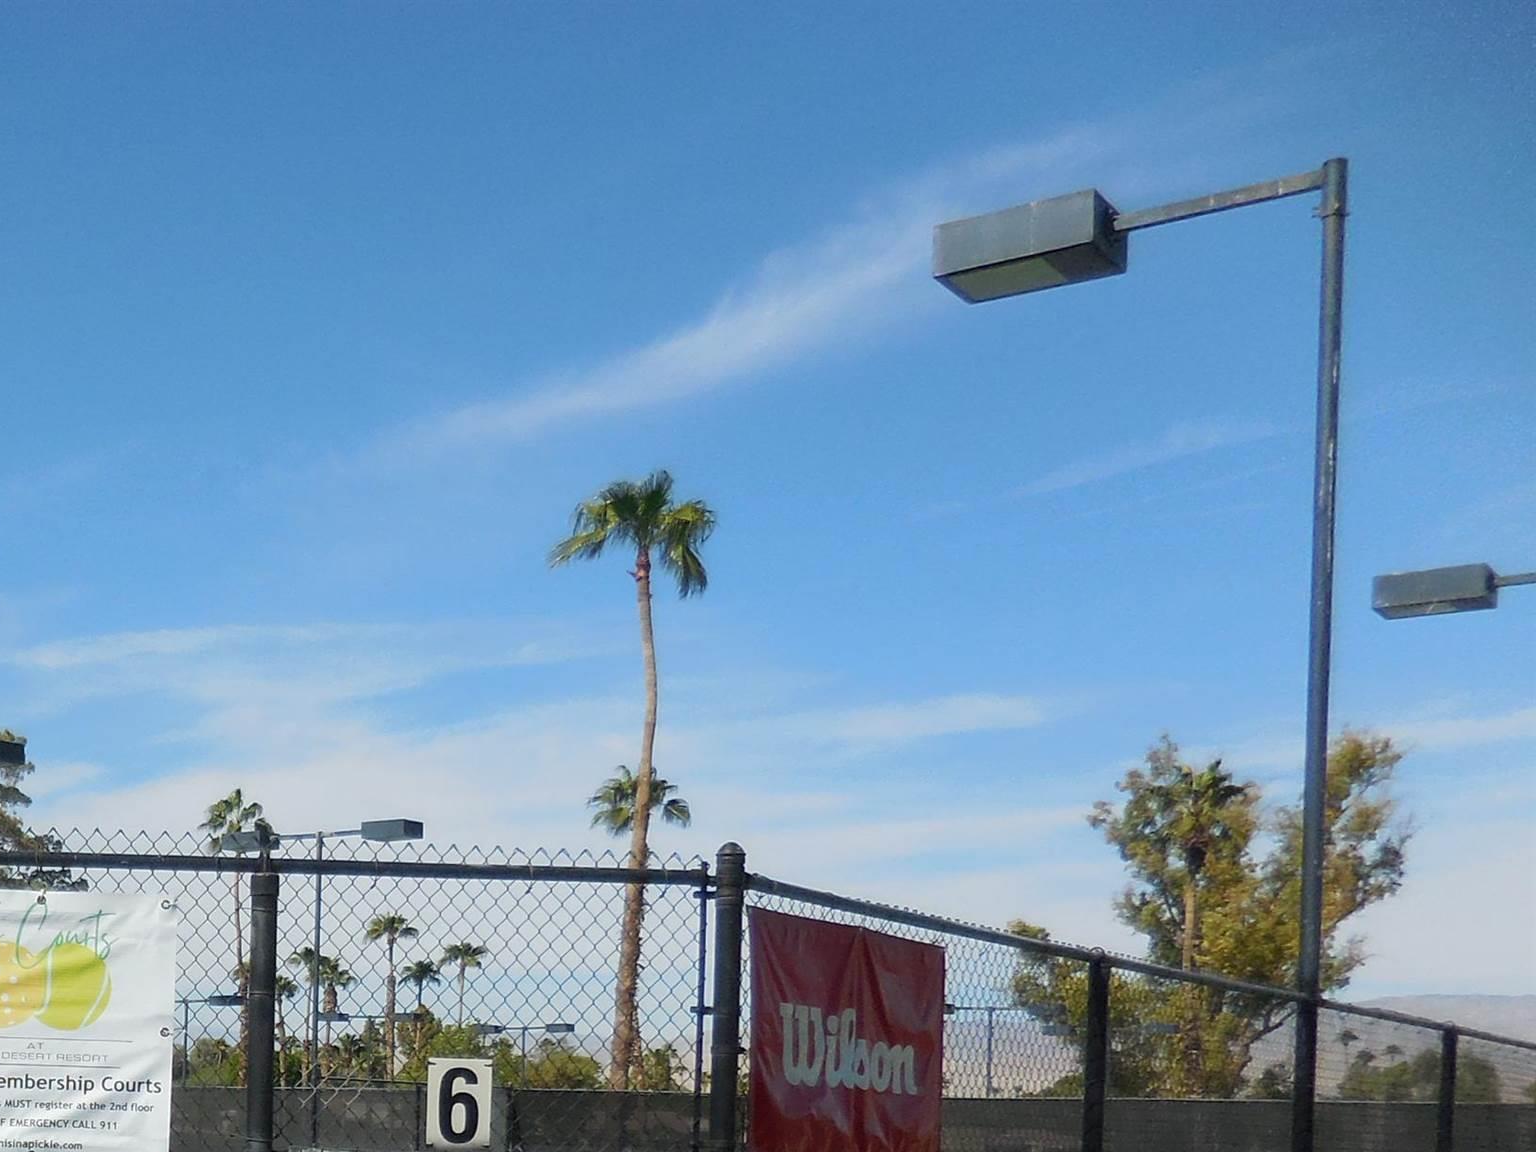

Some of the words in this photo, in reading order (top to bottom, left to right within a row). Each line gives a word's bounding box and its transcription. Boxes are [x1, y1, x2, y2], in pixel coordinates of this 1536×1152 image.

[16, 901, 121, 970] Courts
[26, 1041, 44, 1050] AT
[779, 1002, 918, 1096] Wilson
[1, 1051, 52, 1061] DESERT
[56, 1053, 109, 1063] RESORT
[101, 1076, 162, 1093] Courts
[4, 1099, 32, 1109] MUST
[34, 1099, 74, 1111] register
[76, 1102, 87, 1111] at
[89, 1101, 106, 1111] the
[109, 1102, 128, 1112] 2nd
[131, 1102, 155, 1112] floor
[439, 1067, 479, 1144] 6
[9, 1118, 70, 1129] EMERGENCY
[71, 1120, 96, 1129] CALL
[100, 1120, 118, 1130] 911
